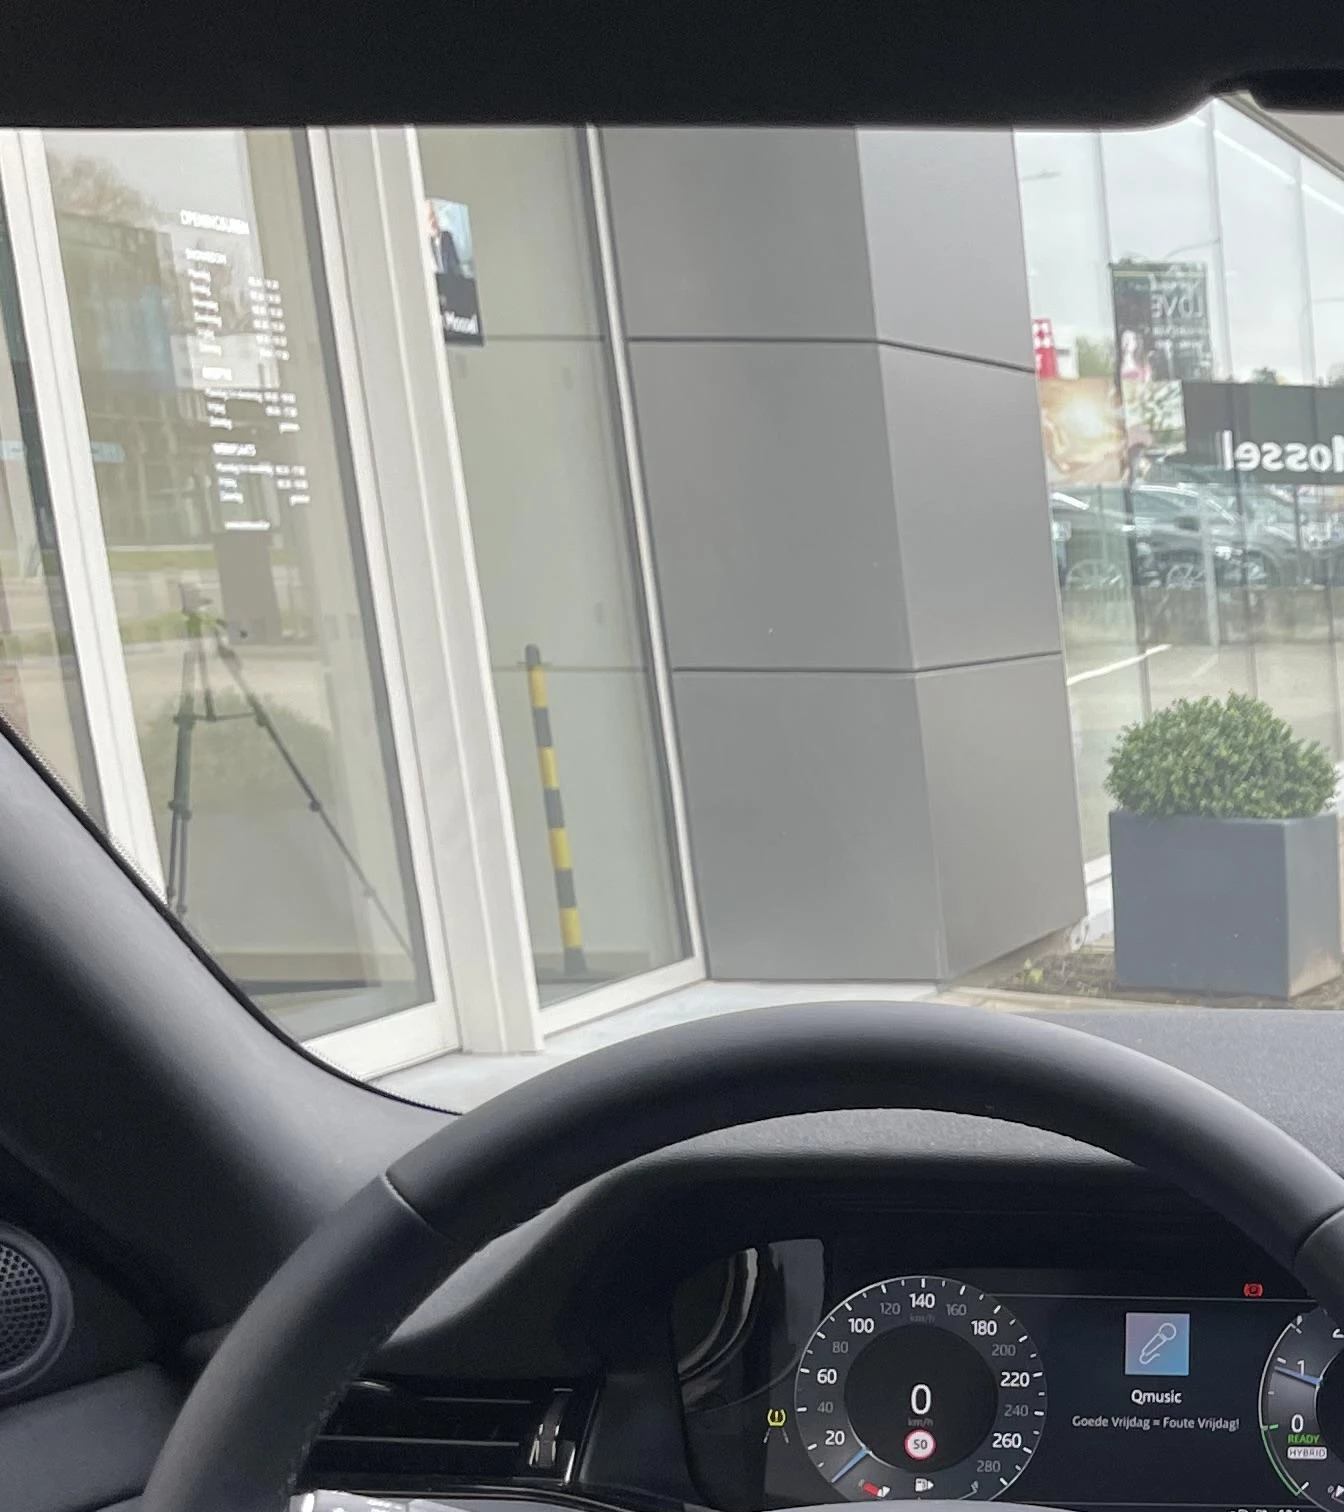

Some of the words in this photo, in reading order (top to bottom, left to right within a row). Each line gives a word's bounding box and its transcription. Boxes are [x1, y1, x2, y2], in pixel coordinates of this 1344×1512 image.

[880, 1302, 901, 1315] 120
[909, 1293, 935, 1309] 140
[946, 1303, 967, 1316] 160
[848, 1317, 875, 1334] 100
[970, 1319, 998, 1336] 180
[832, 1341, 849, 1354] 80
[991, 1344, 1017, 1357] 200
[816, 1368, 838, 1385] 60
[1000, 1371, 1031, 1388] 220
[910, 1383, 932, 1415] 0
[1131, 1388, 1184, 1405] Qmusic
[817, 1401, 834, 1414] 40
[1004, 1404, 1029, 1417] 240
[1072, 1415, 1109, 1428] Goede
[1111, 1415, 1151, 1431] Vrijdag
[1162, 1416, 1195, 1429] Foute
[1197, 1417, 1240, 1432] Vrijdag!
[1291, 1414, 1304, 1433] 0
[825, 1430, 846, 1446] 20
[913, 1439, 928, 1450] 50
[992, 1432, 1022, 1449] 260
[1287, 1434, 1320, 1444] READY
[1288, 1449, 1326, 1458] HYBRID
[976, 1460, 1001, 1473] 280
